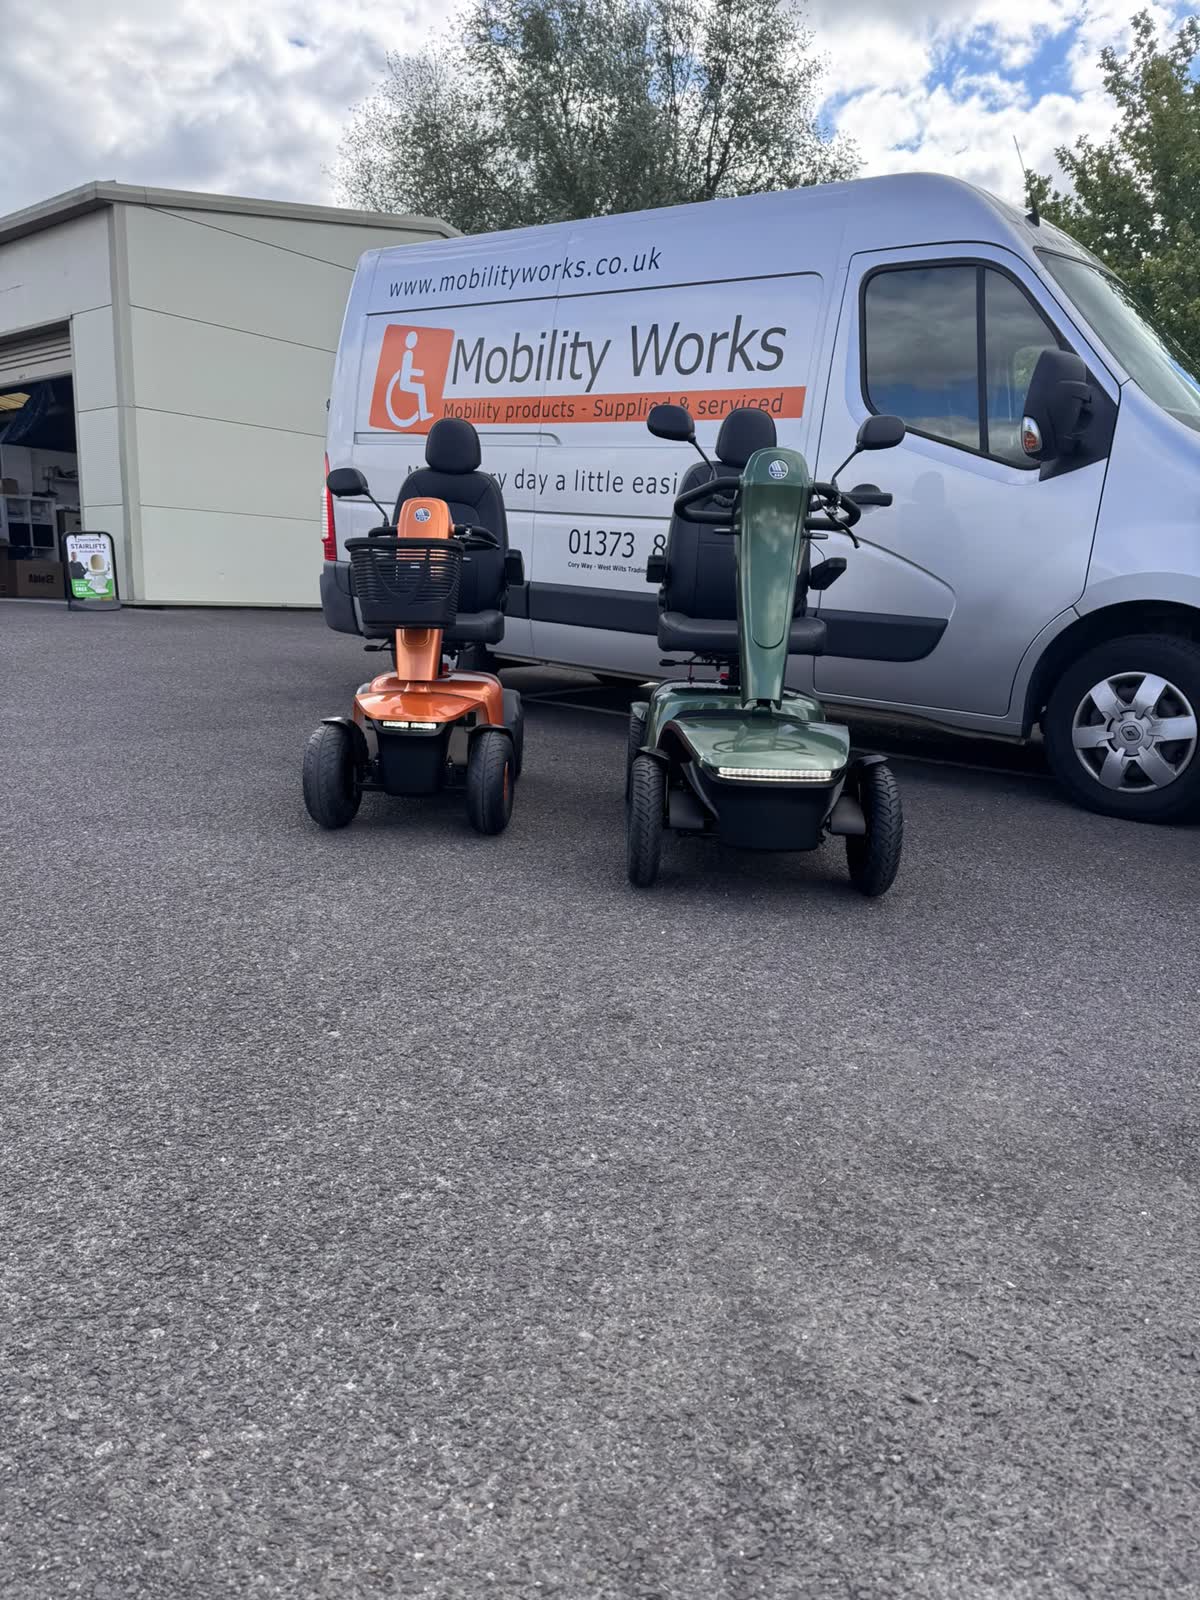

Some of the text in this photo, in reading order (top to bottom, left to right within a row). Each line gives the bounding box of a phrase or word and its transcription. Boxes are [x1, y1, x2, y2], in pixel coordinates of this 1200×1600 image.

[389, 246, 662, 298] www.mobilityworks.co.uk
[452, 314, 787, 393] Mobility Works
[443, 402, 501, 423] Mobility
[505, 399, 575, 422] products
[697, 392, 784, 415] serviced
[514, 468, 549, 495] day
[555, 474, 566, 491] a
[574, 469, 624, 493] little
[632, 472, 678, 495] easi
[568, 528, 666, 558] 01373 8
[567, 561, 580, 569] Cory
[581, 562, 593, 570] Way
[597, 563, 611, 571] West
[612, 564, 627, 572] Wilts
[628, 566, 647, 574] Tradin
